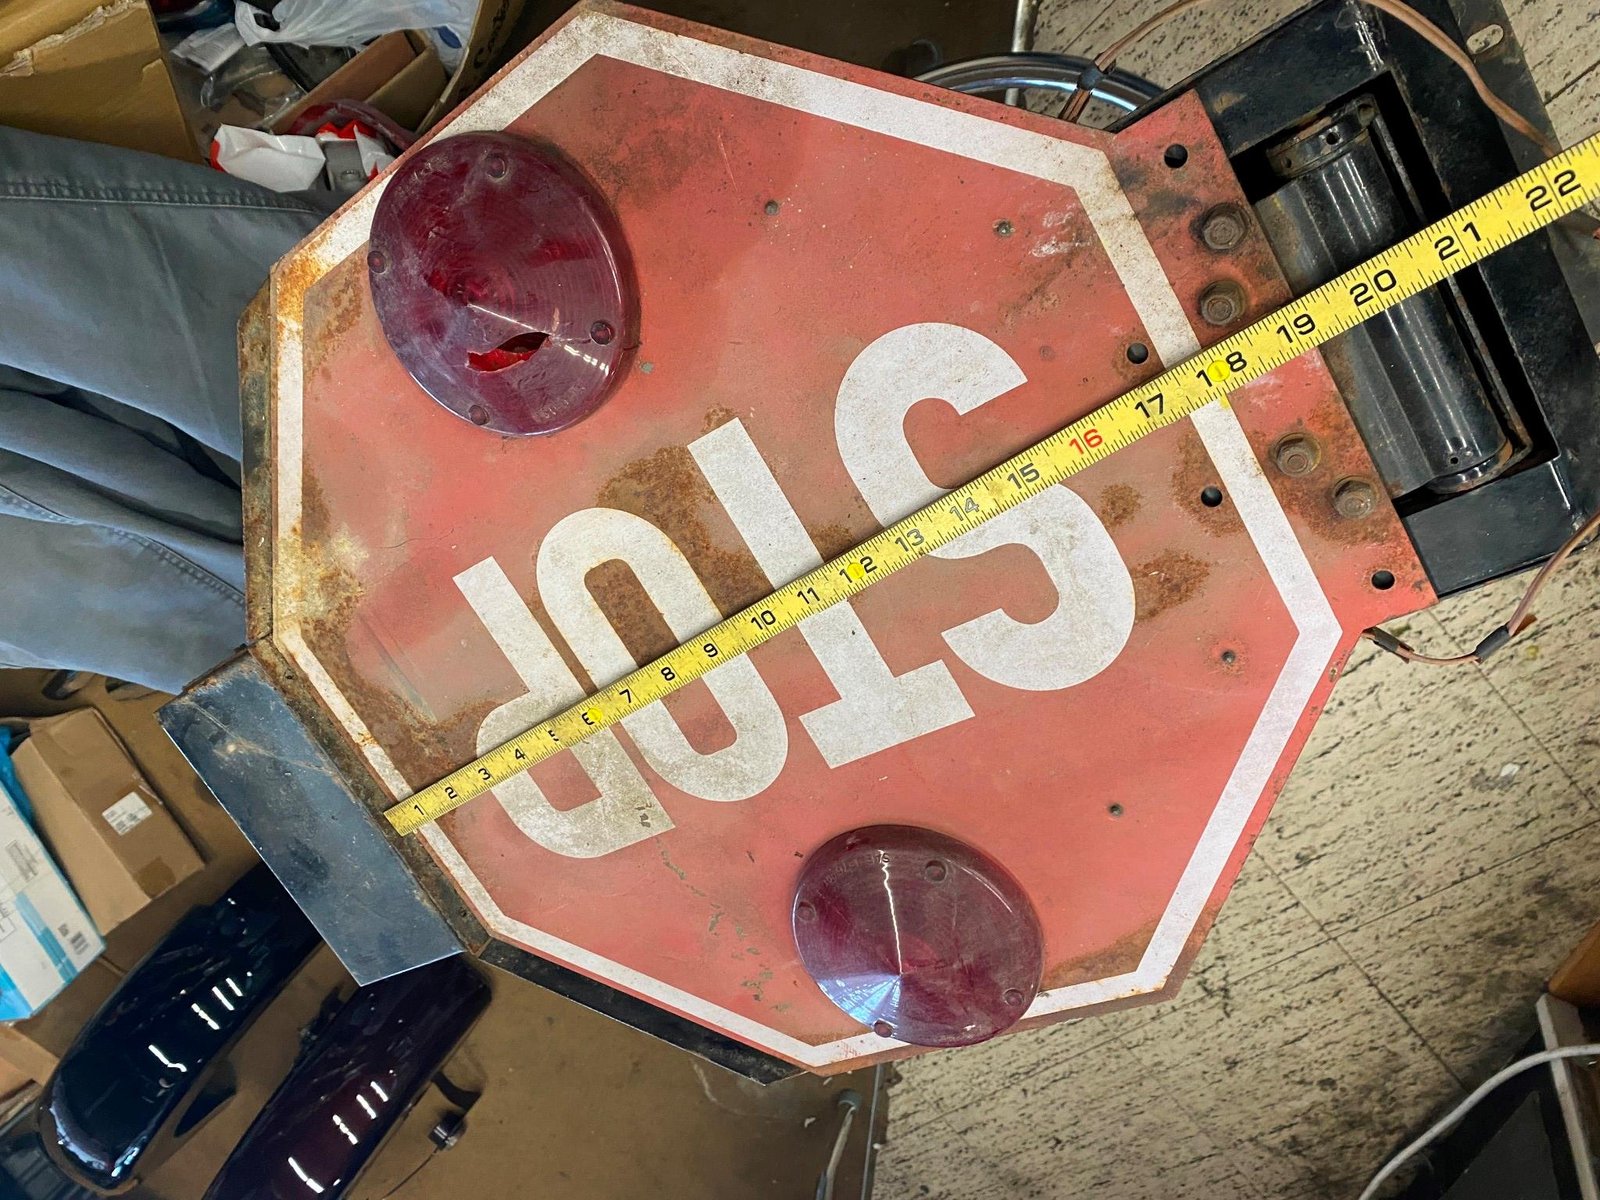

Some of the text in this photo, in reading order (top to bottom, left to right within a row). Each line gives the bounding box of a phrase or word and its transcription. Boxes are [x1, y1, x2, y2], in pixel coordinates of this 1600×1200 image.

[413, 803, 426, 818] 1
[443, 785, 458, 800] 2
[477, 767, 491, 781] 3
[513, 747, 526, 761] 4
[618, 688, 633, 704] 7
[659, 665, 676, 682] 8
[702, 643, 719, 659] 9
[750, 609, 778, 631] 10
[796, 586, 822, 605] 11
[838, 555, 878, 584] 12
[894, 527, 926, 553] 13
[949, 496, 981, 522] 14
[1006, 462, 1041, 489] 15
[1068, 428, 1103, 455] 16
[1133, 392, 1165, 419] 17
[1195, 350, 1248, 388] 18
[1276, 312, 1317, 344] 19
[1349, 268, 1398, 307] 20
[1434, 221, 1483, 262] 21
[1524, 168, 1583, 212] 22
[452, 321, 1136, 858] STOP
